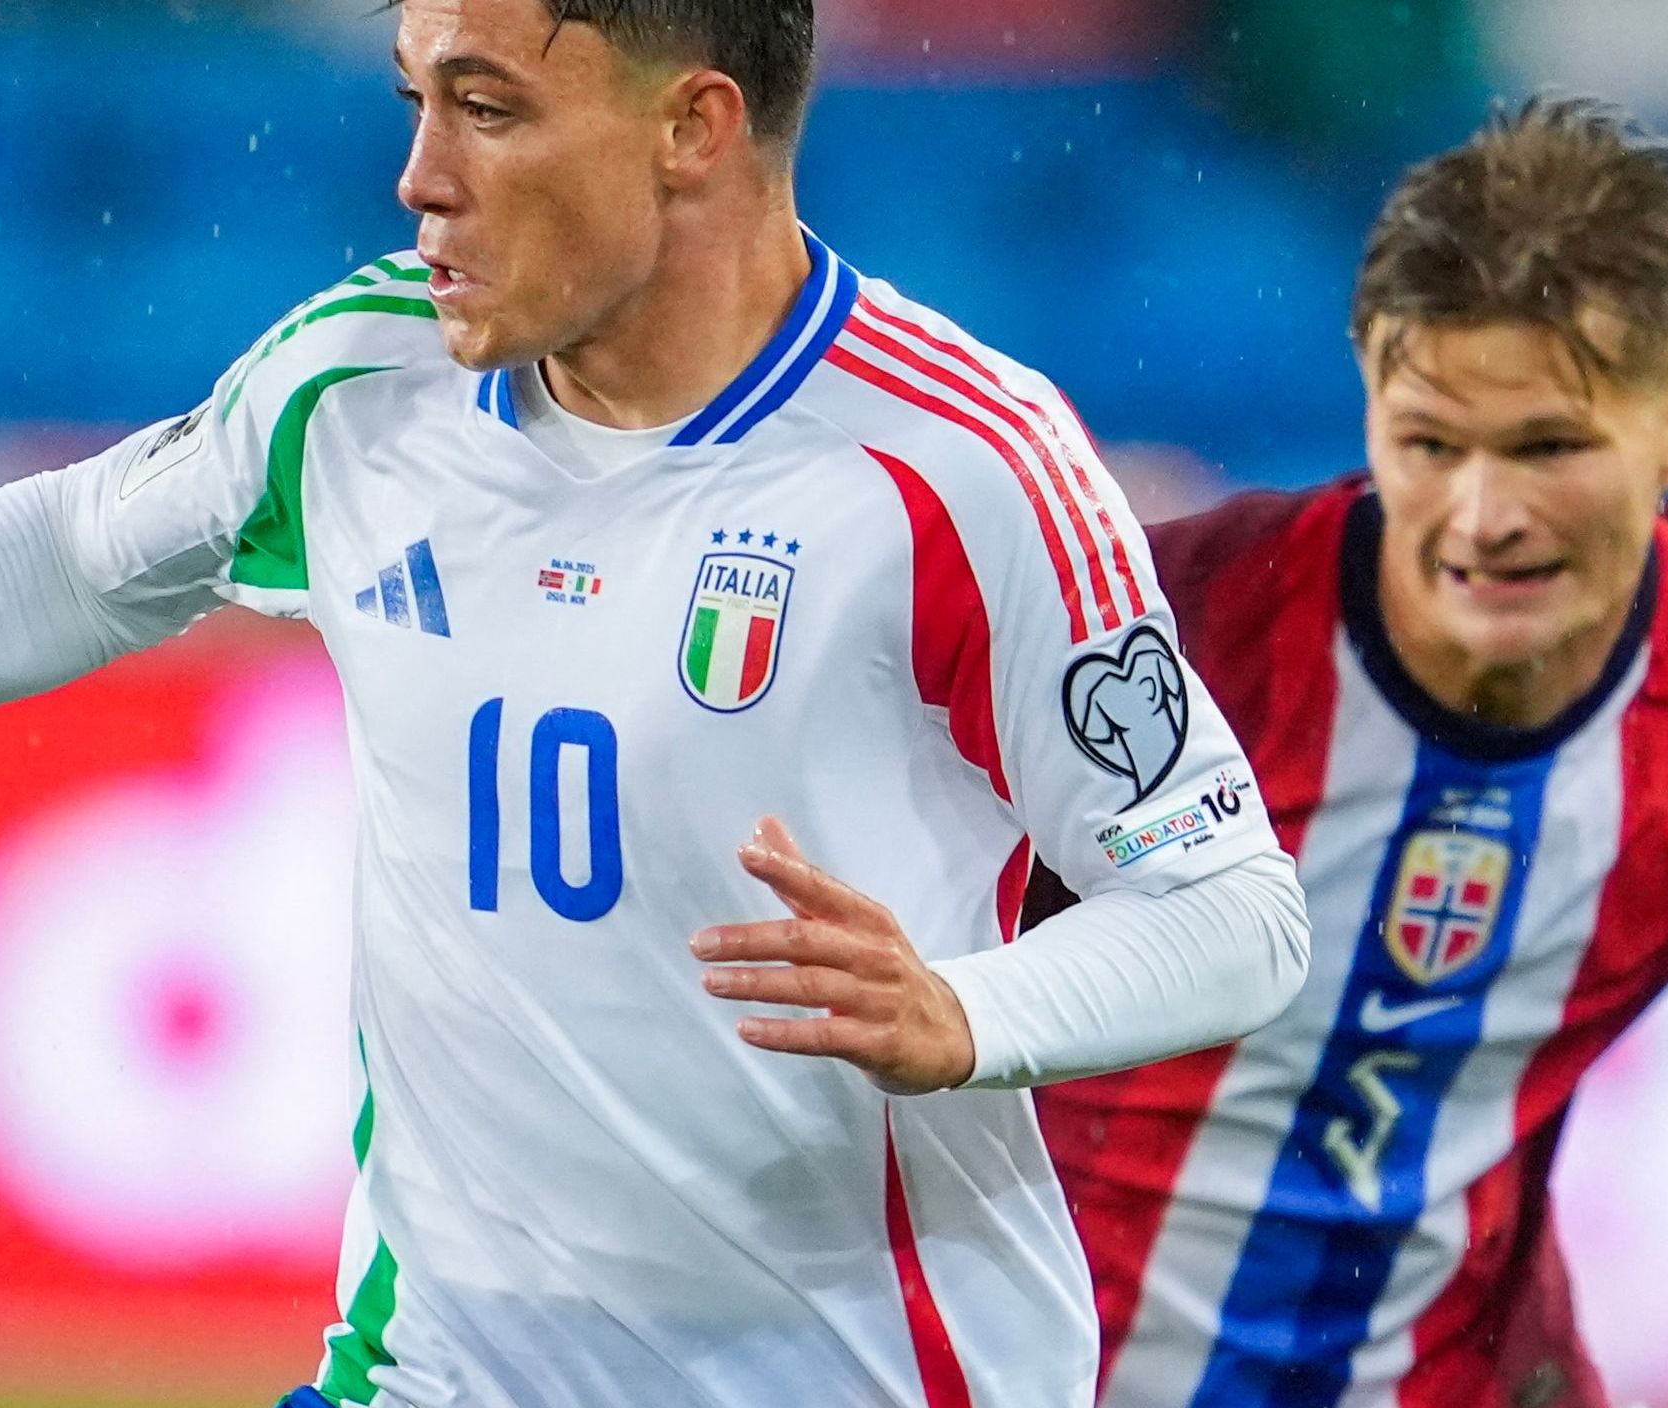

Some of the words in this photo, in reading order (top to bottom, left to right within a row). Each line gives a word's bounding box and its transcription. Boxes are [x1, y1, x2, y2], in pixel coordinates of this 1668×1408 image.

[703, 564, 779, 602] ITALIA
[469, 697, 622, 921] 10
[1201, 784, 1241, 823] 10
[1095, 824, 1124, 844] UEFA
[1106, 809, 1206, 863] FOUNDATION
